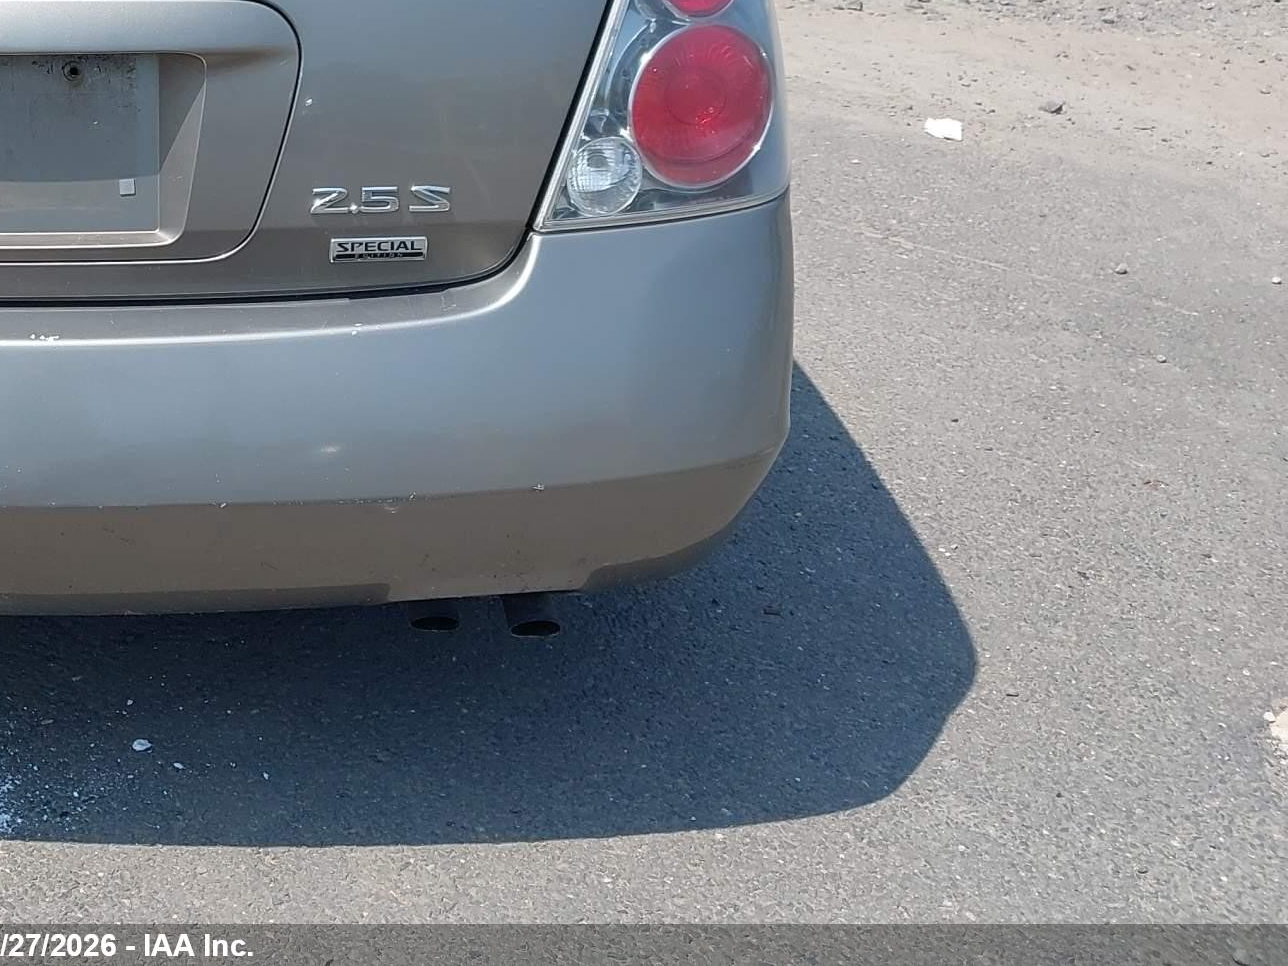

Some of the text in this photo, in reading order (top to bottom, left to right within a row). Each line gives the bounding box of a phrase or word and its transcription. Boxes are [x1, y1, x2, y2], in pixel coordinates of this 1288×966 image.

[310, 185, 451, 214] 2.5 S
[335, 240, 423, 253] SPECIAL
